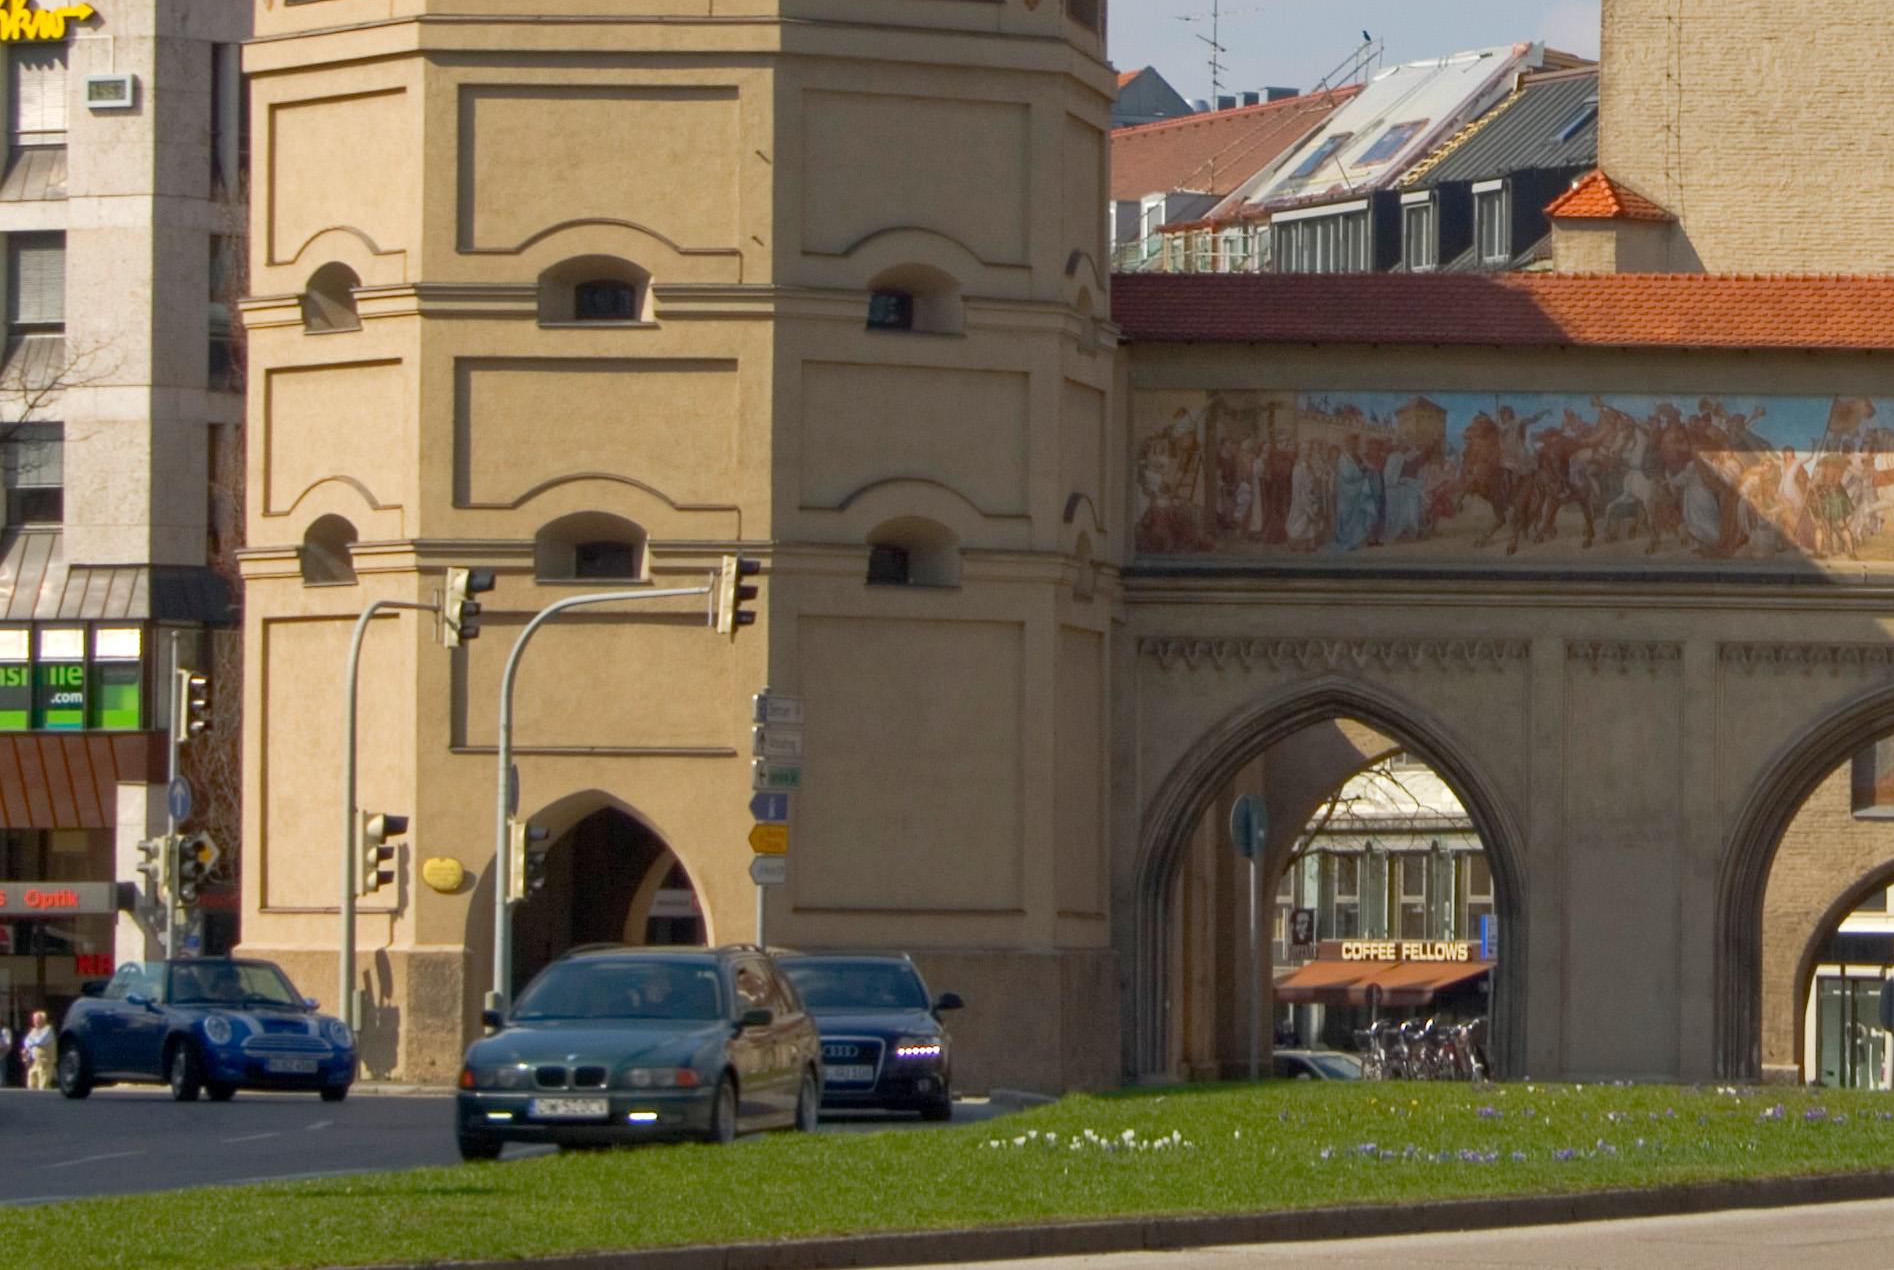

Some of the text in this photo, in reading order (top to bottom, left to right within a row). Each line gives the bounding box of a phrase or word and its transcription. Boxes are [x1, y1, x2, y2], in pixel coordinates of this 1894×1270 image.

[50, 692, 83, 704] .com
[24, 888, 79, 910] Optik
[1341, 942, 1469, 961] COFFEE FELLOWS
